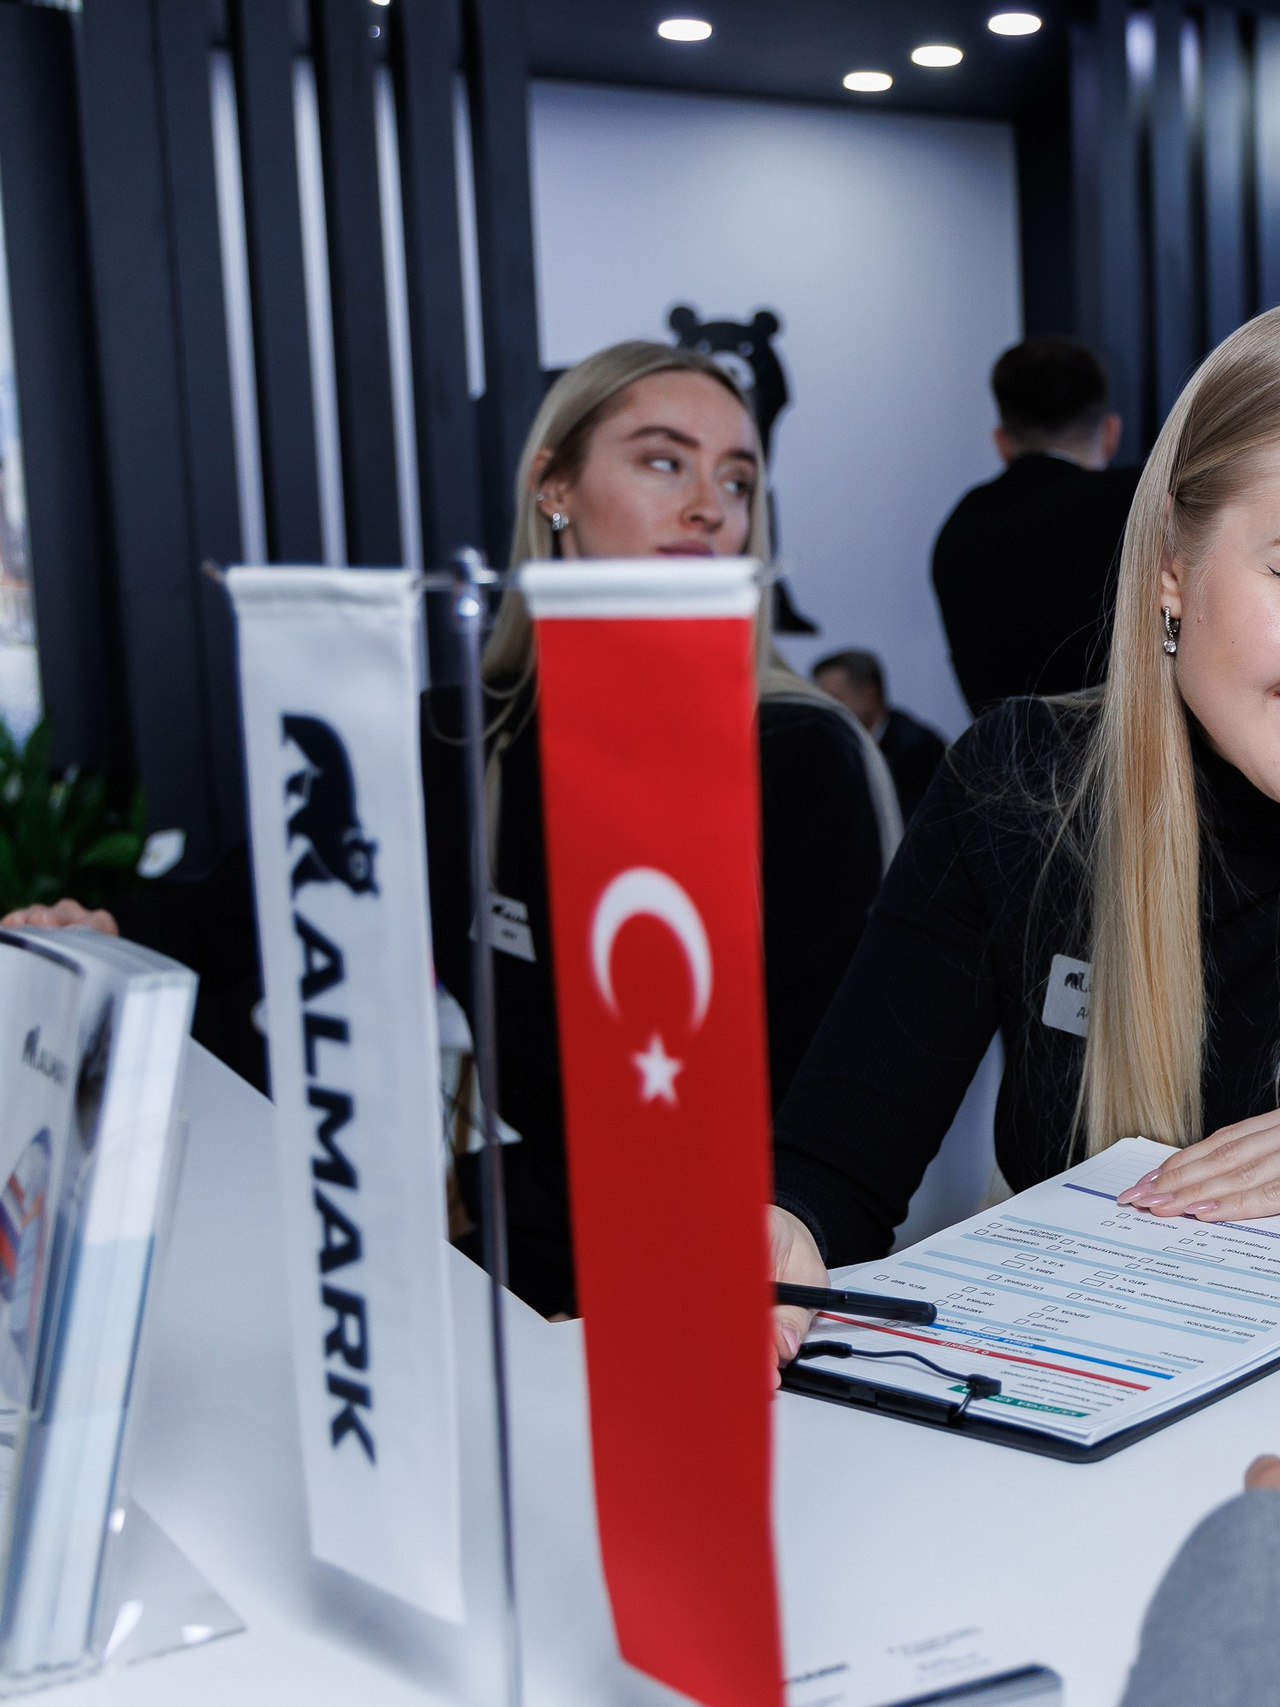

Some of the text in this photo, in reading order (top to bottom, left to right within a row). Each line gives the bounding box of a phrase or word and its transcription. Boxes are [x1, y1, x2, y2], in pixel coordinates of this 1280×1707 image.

[293, 909, 377, 1467] ALMARK
[1032, 1267, 1056, 1275] АВИА
[949, 1304, 985, 1314] АМЕРИКА
[1058, 1309, 1092, 1318] ЕВРОПА
